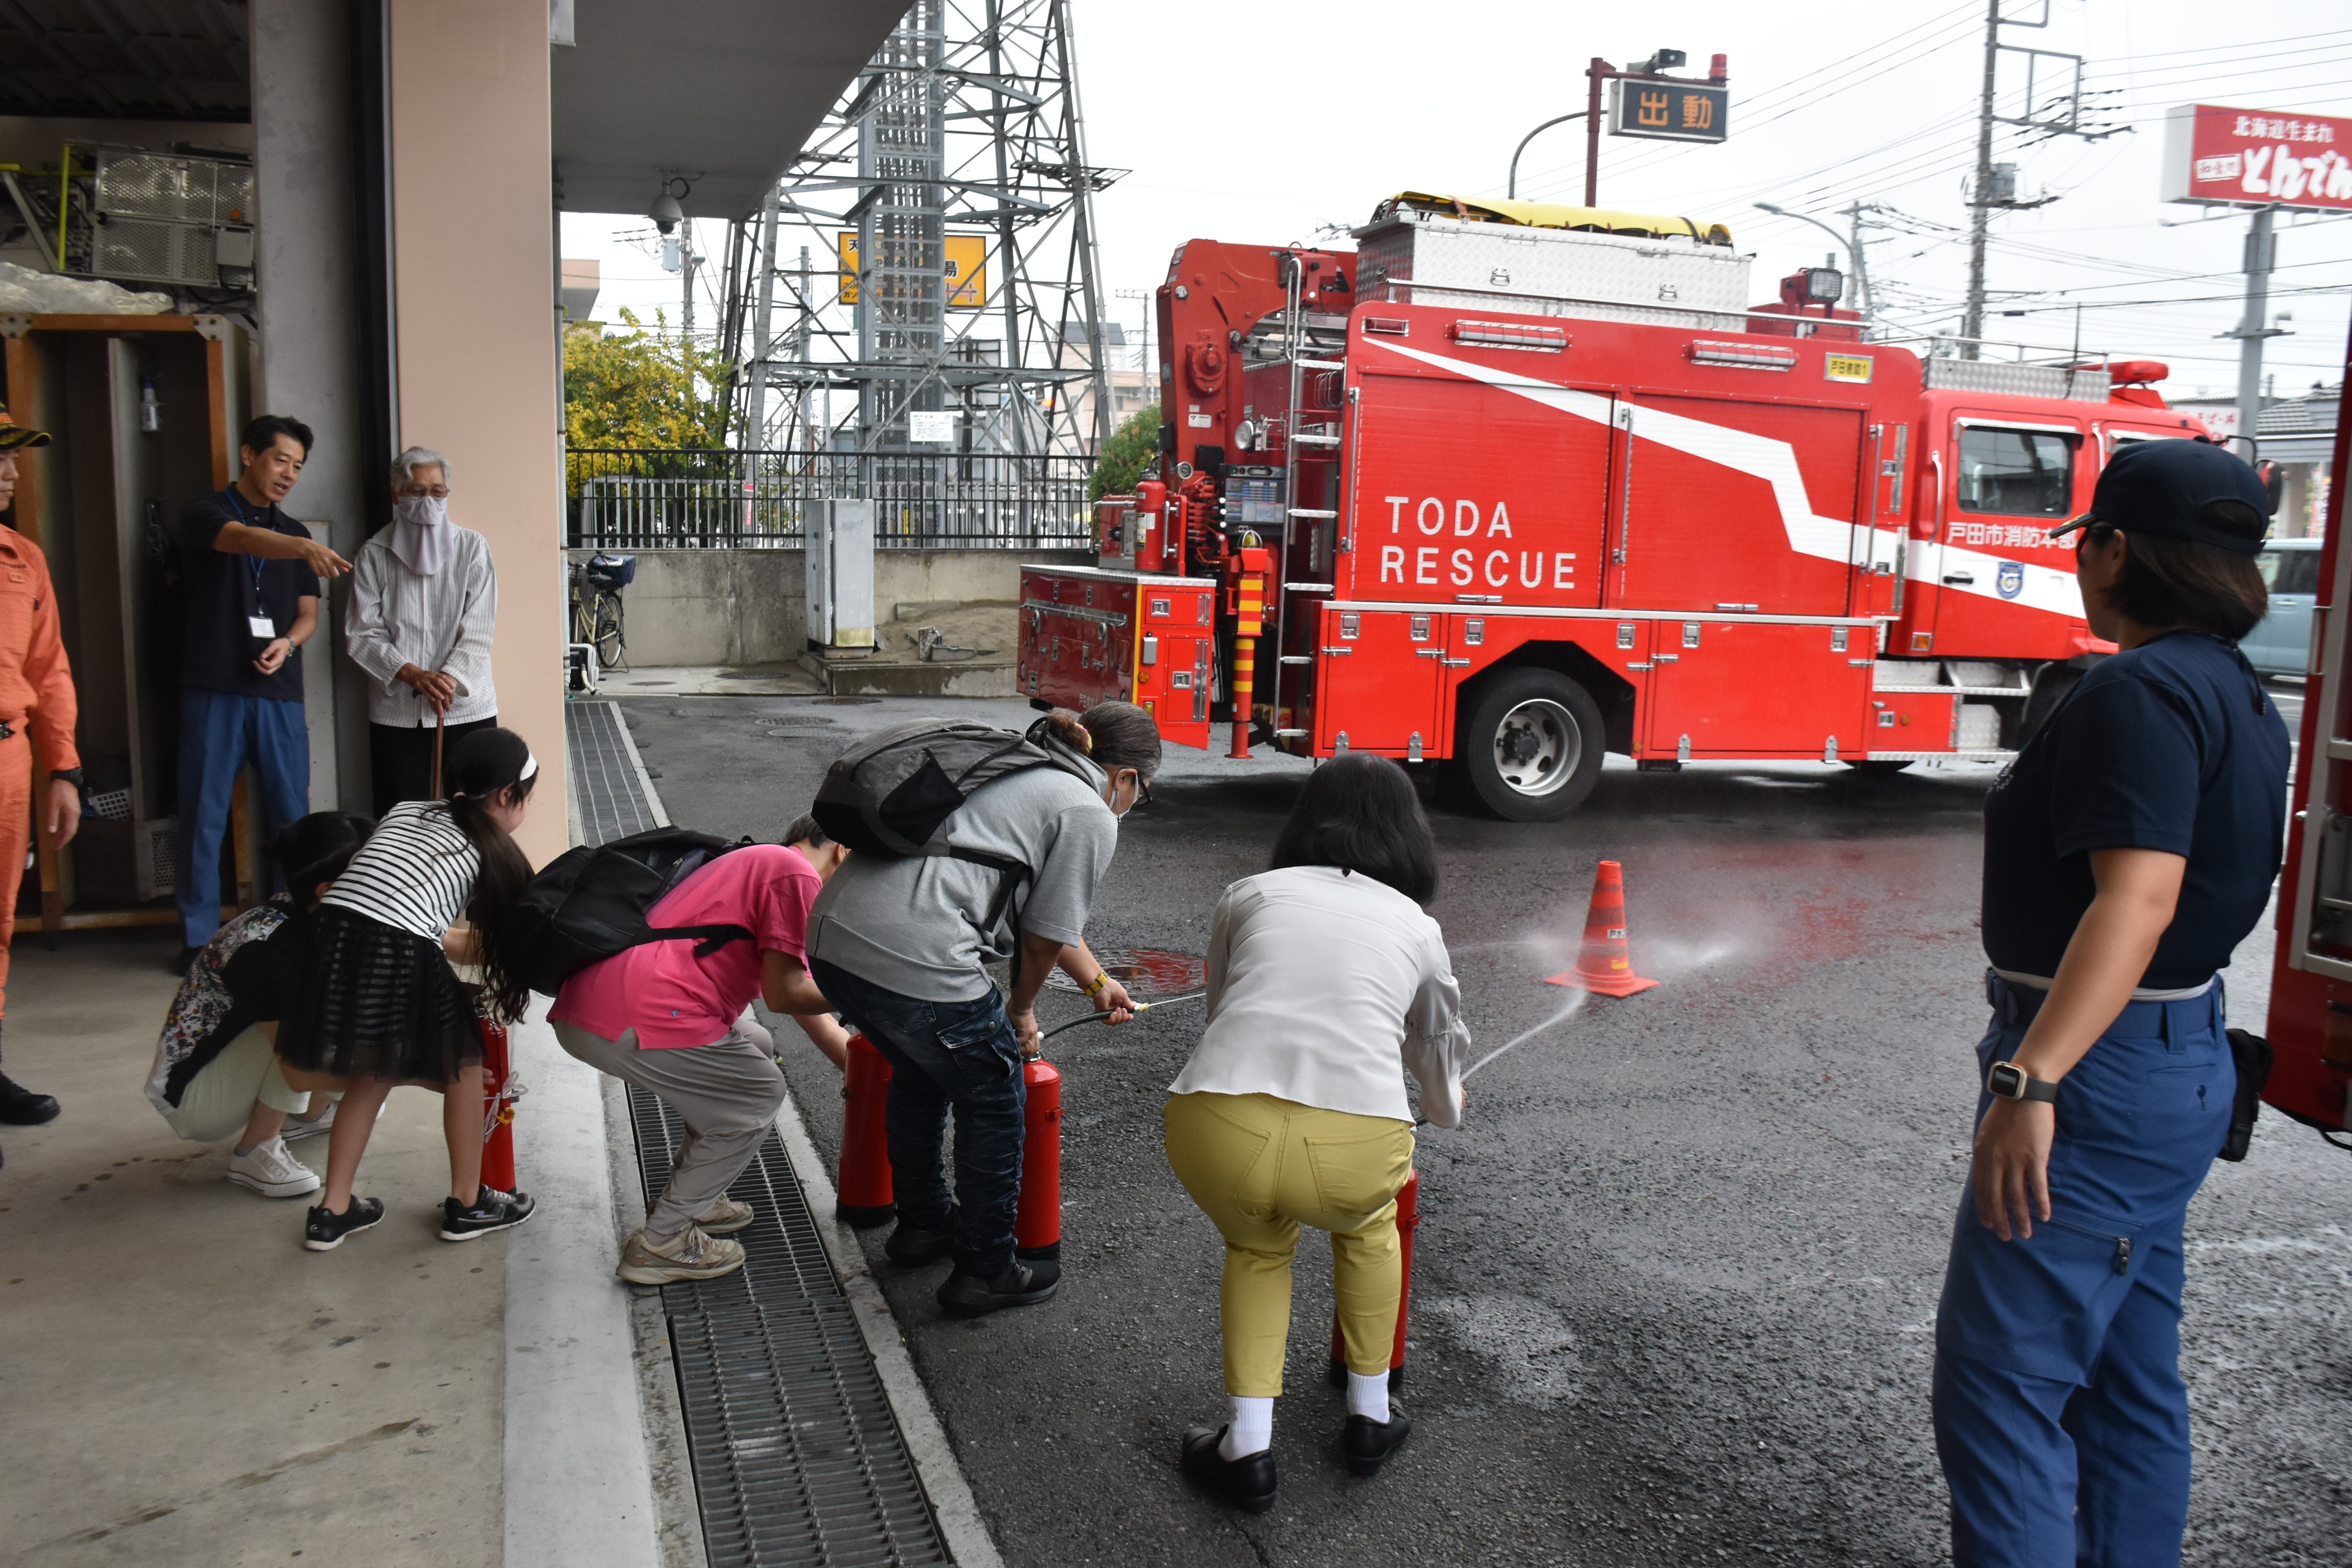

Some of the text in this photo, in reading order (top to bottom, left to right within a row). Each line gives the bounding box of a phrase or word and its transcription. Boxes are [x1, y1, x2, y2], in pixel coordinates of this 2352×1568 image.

[1639, 92, 1712, 129] 出動
[2232, 116, 2335, 143] 北海道生まれ
[1385, 496, 1512, 538] TODA
[1947, 522, 2077, 550] 戸田市消防本部
[1381, 545, 1576, 588] RESCUE
